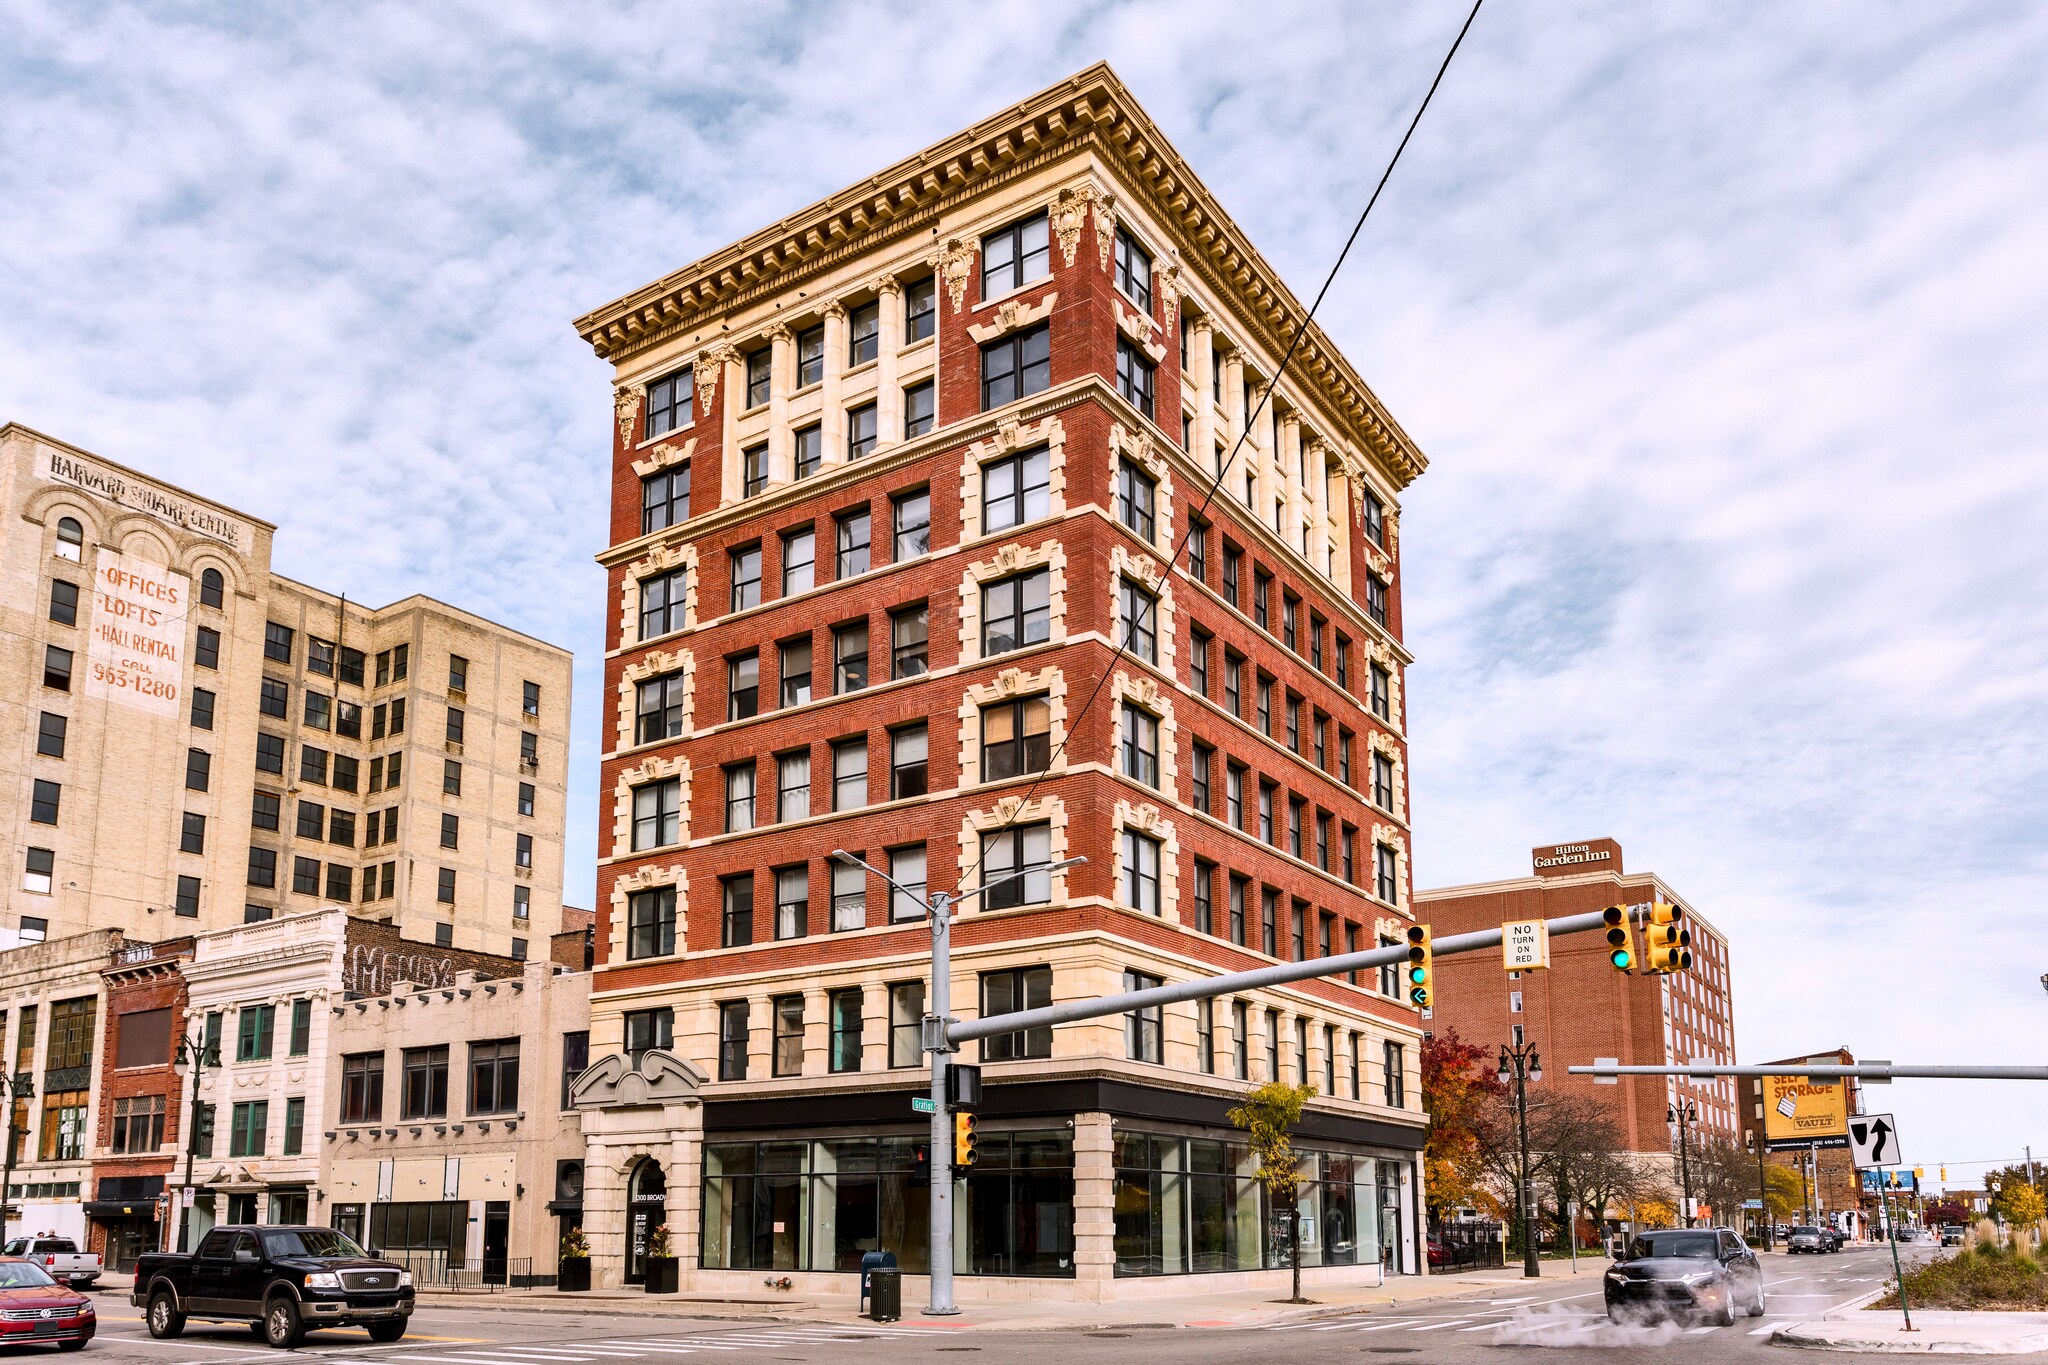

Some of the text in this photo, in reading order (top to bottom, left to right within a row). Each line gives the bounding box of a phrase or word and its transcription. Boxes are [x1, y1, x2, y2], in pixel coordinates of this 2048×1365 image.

[50, 454, 125, 497] HARVARD
[190, 508, 240, 543] CENTRE
[107, 566, 178, 604] OFFICES
[104, 594, 158, 627] LOFTS
[102, 623, 177, 663] HALL RENTAL
[121, 658, 153, 675] CALL
[93, 662, 177, 701] 963-1280
[1555, 845, 1589, 855] Hilton
[1534, 850, 1610, 868] Garden Inn
[1514, 925, 1532, 935] NO
[1512, 936, 1534, 944] TURN
[1517, 946, 1530, 954] ON
[1515, 955, 1532, 963] RED
[1774, 1084, 1833, 1099] STORAGE
[1796, 1118, 1833, 1127] VAULT
